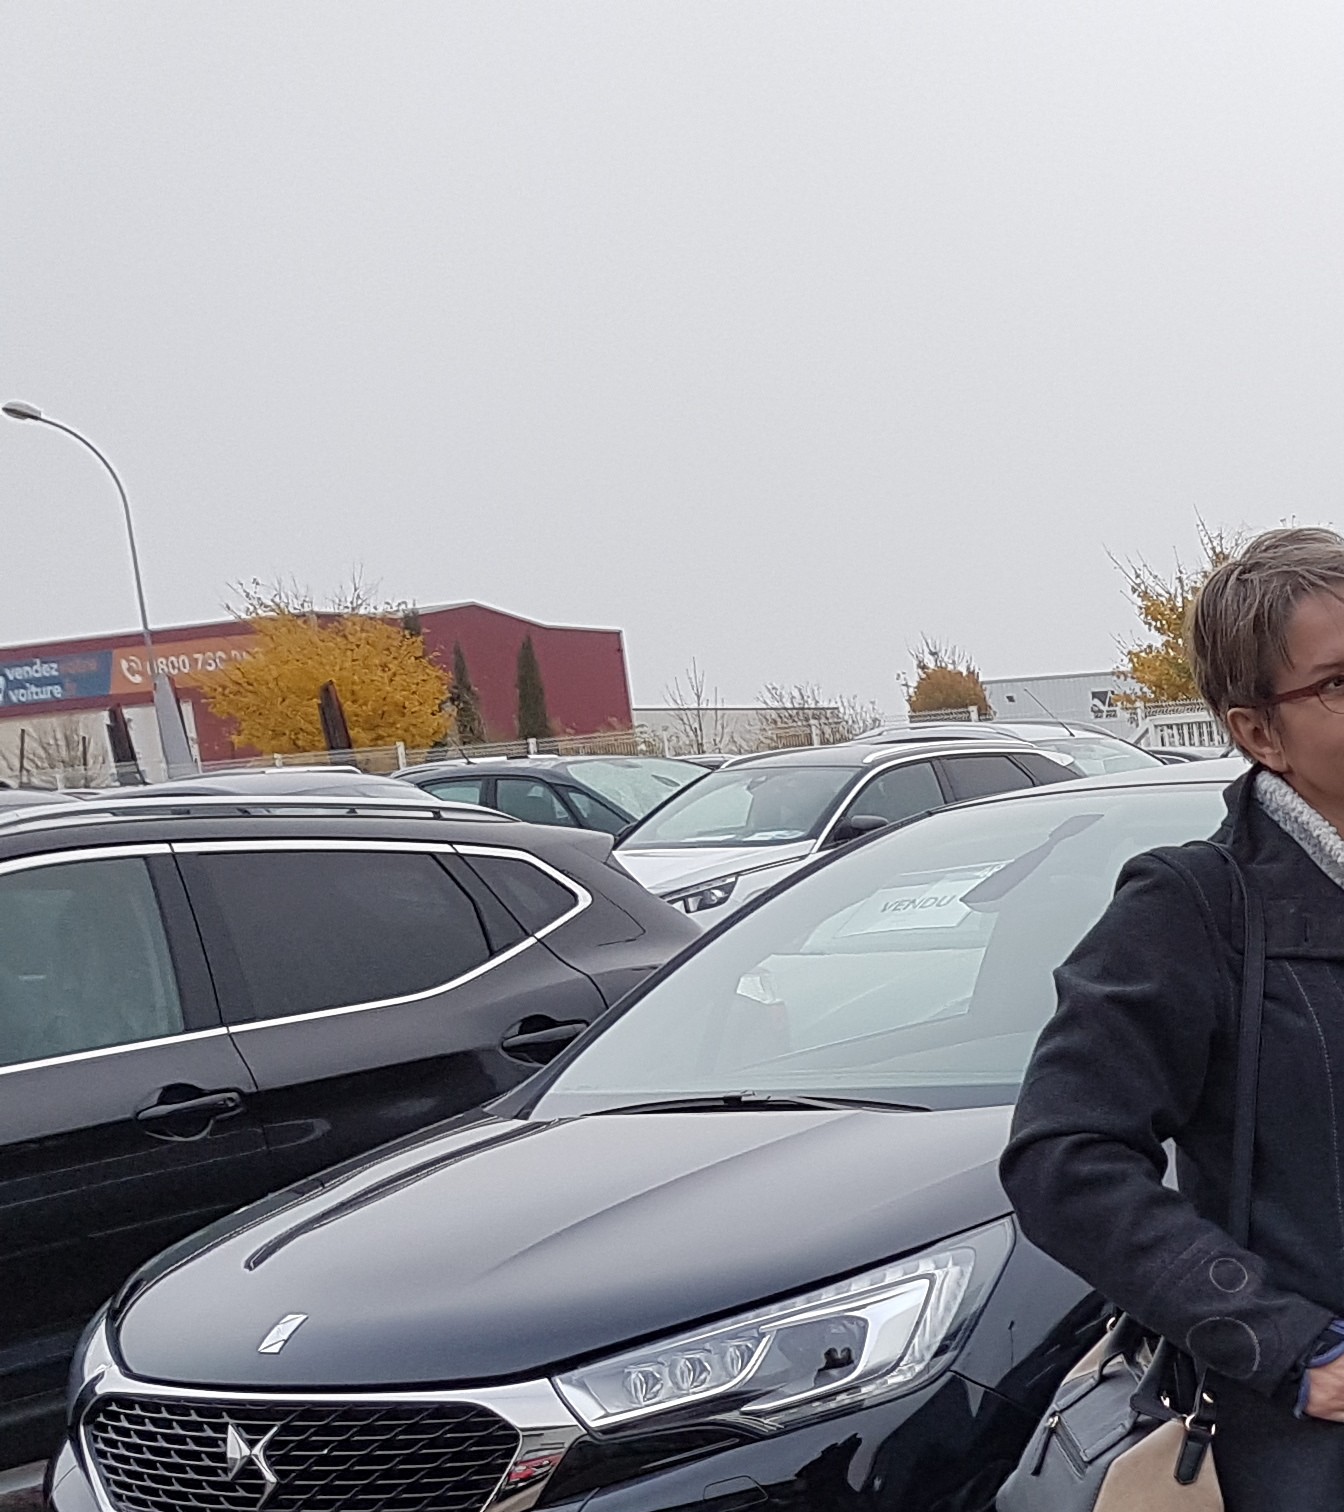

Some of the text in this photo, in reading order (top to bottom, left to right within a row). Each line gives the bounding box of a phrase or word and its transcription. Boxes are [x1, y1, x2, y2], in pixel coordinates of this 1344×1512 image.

[4, 658, 59, 680] vendez
[8, 683, 62, 703] voiture
[881, 895, 956, 913] VENDU
